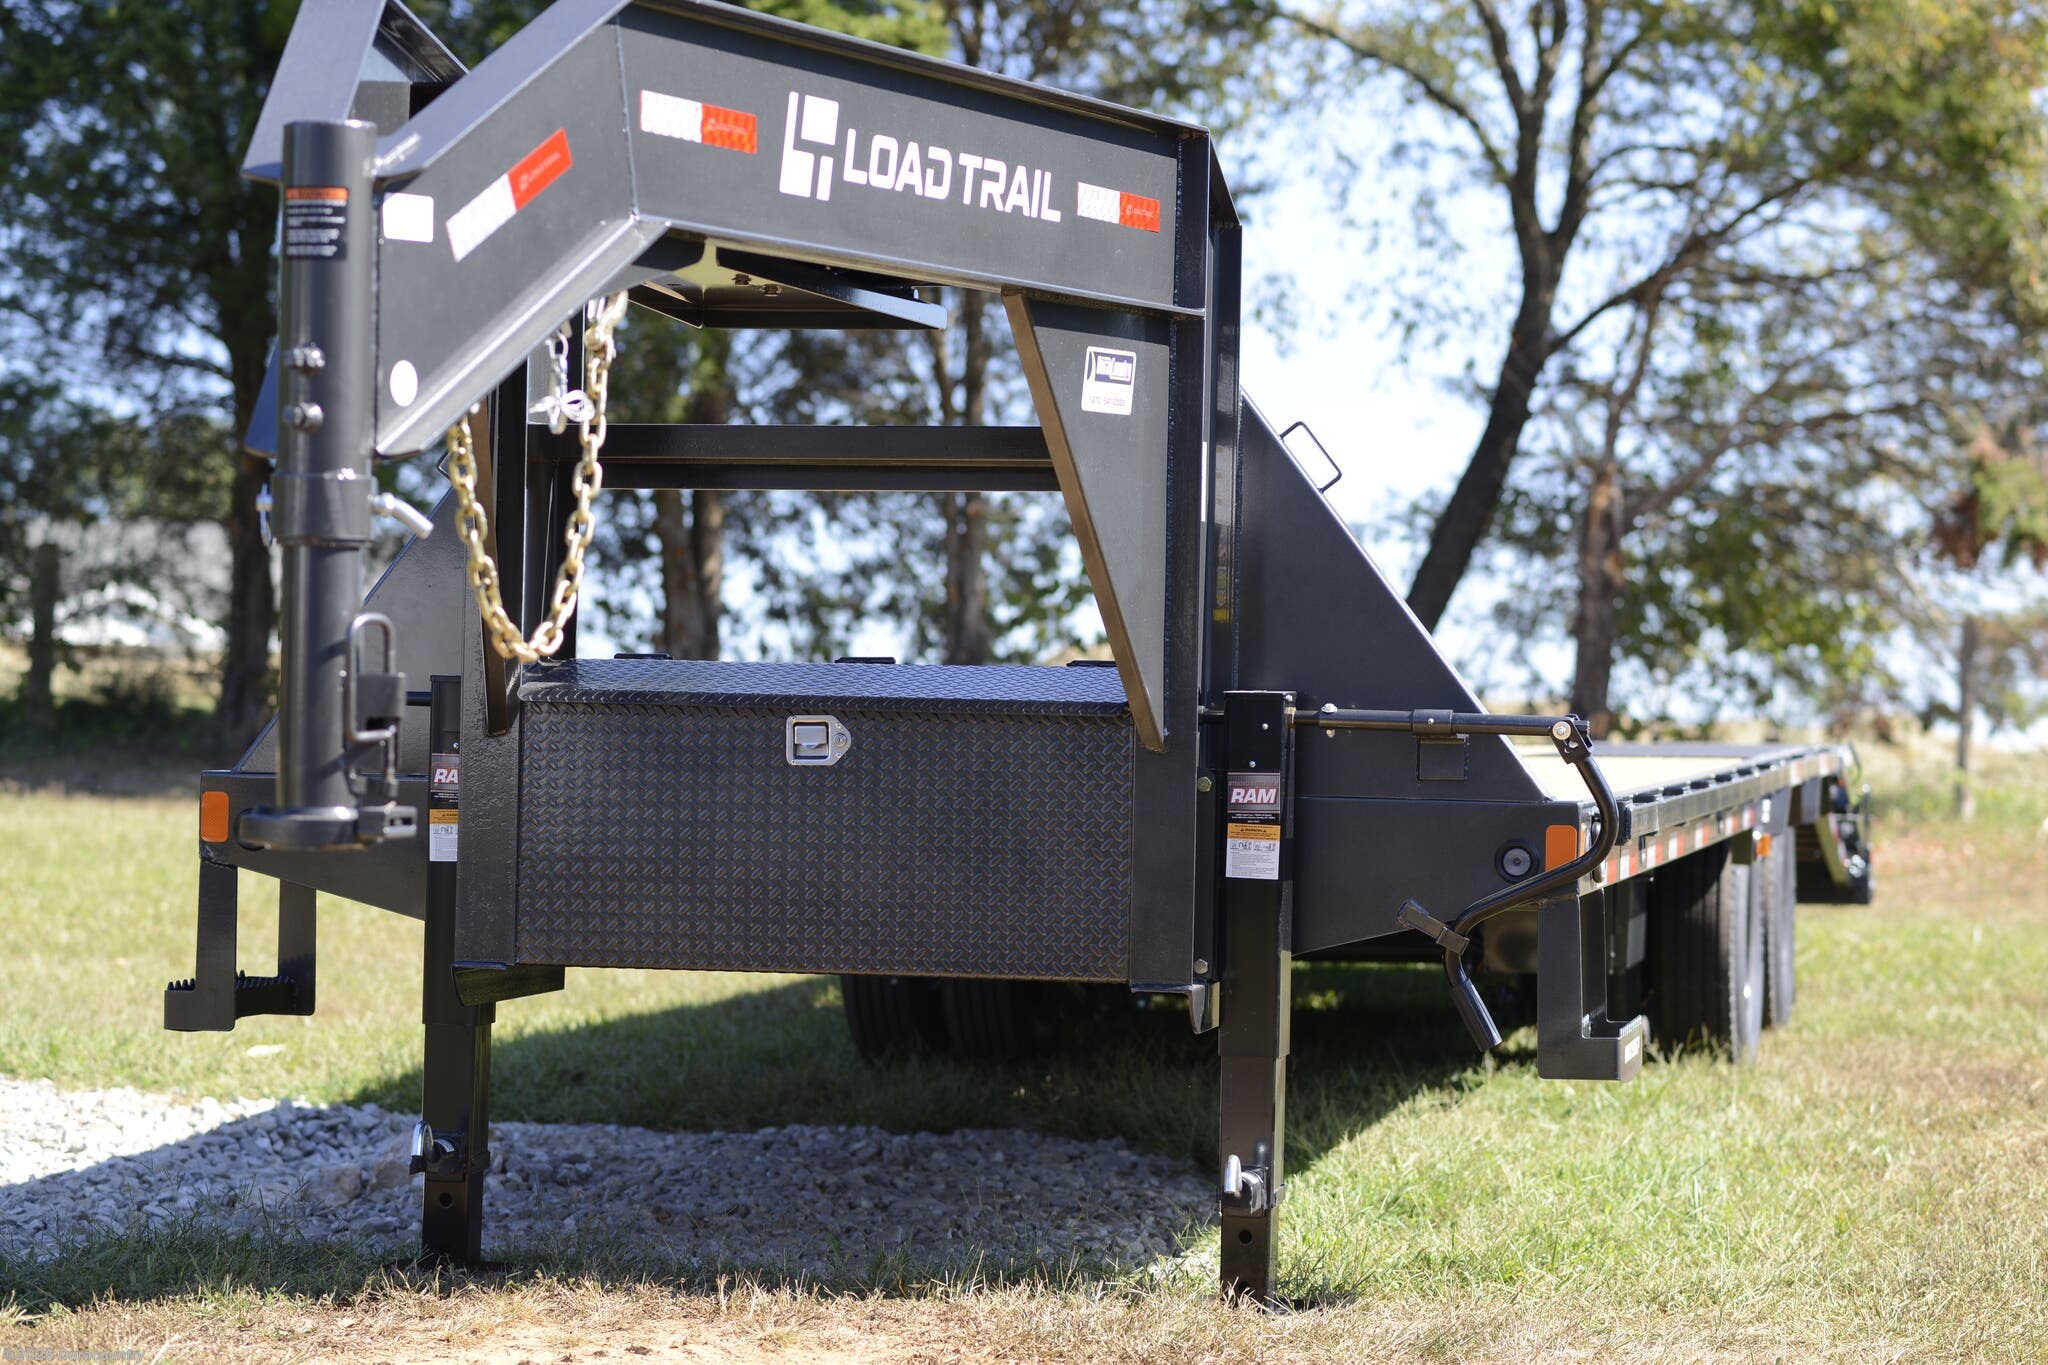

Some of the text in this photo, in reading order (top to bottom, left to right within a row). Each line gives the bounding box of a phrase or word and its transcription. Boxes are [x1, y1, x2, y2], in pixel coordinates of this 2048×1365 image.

[843, 128, 1062, 223] LOAD TRAIL
[433, 768, 459, 783] RA
[1230, 788, 1277, 804] RAM
